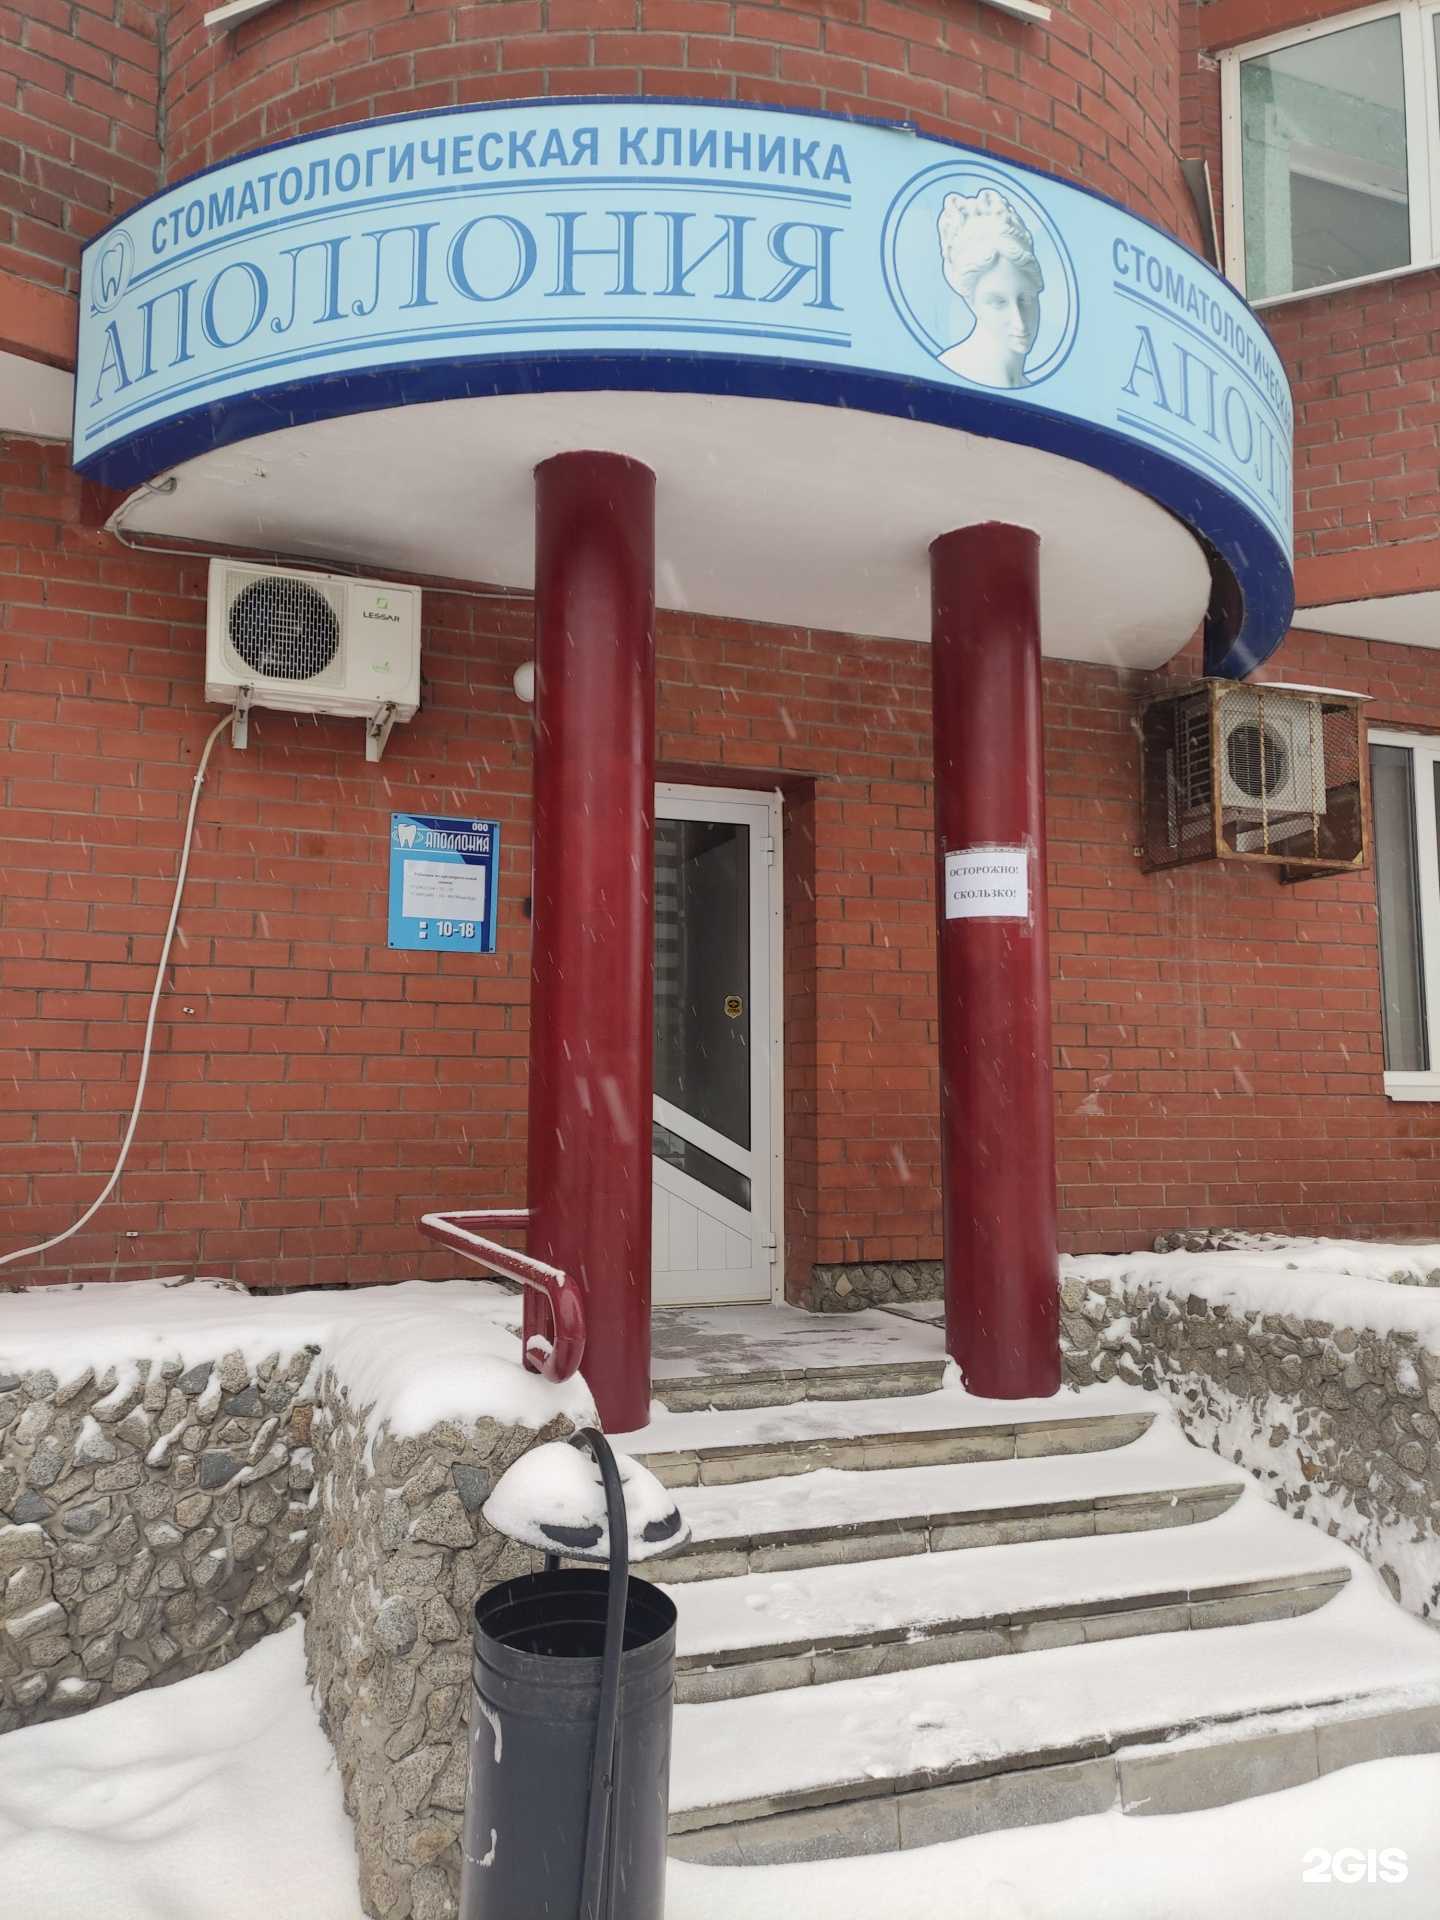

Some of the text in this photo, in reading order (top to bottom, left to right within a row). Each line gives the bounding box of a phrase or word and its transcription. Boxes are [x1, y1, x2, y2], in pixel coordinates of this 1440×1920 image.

[152, 126, 852, 255] СТОМАТОЛОГИЧЕСКАЯ КЛИНИКА
[89, 210, 845, 408] АПОЛЛОНИЯ
[362, 610, 400, 623] LESSAR
[425, 831, 490, 853] АПОЛЛОНИЯ
[949, 865, 1019, 877] ОСТОРОЖНО!
[953, 888, 1017, 901] СКОЛЬЗКО!
[436, 921, 475, 938] 10-18
